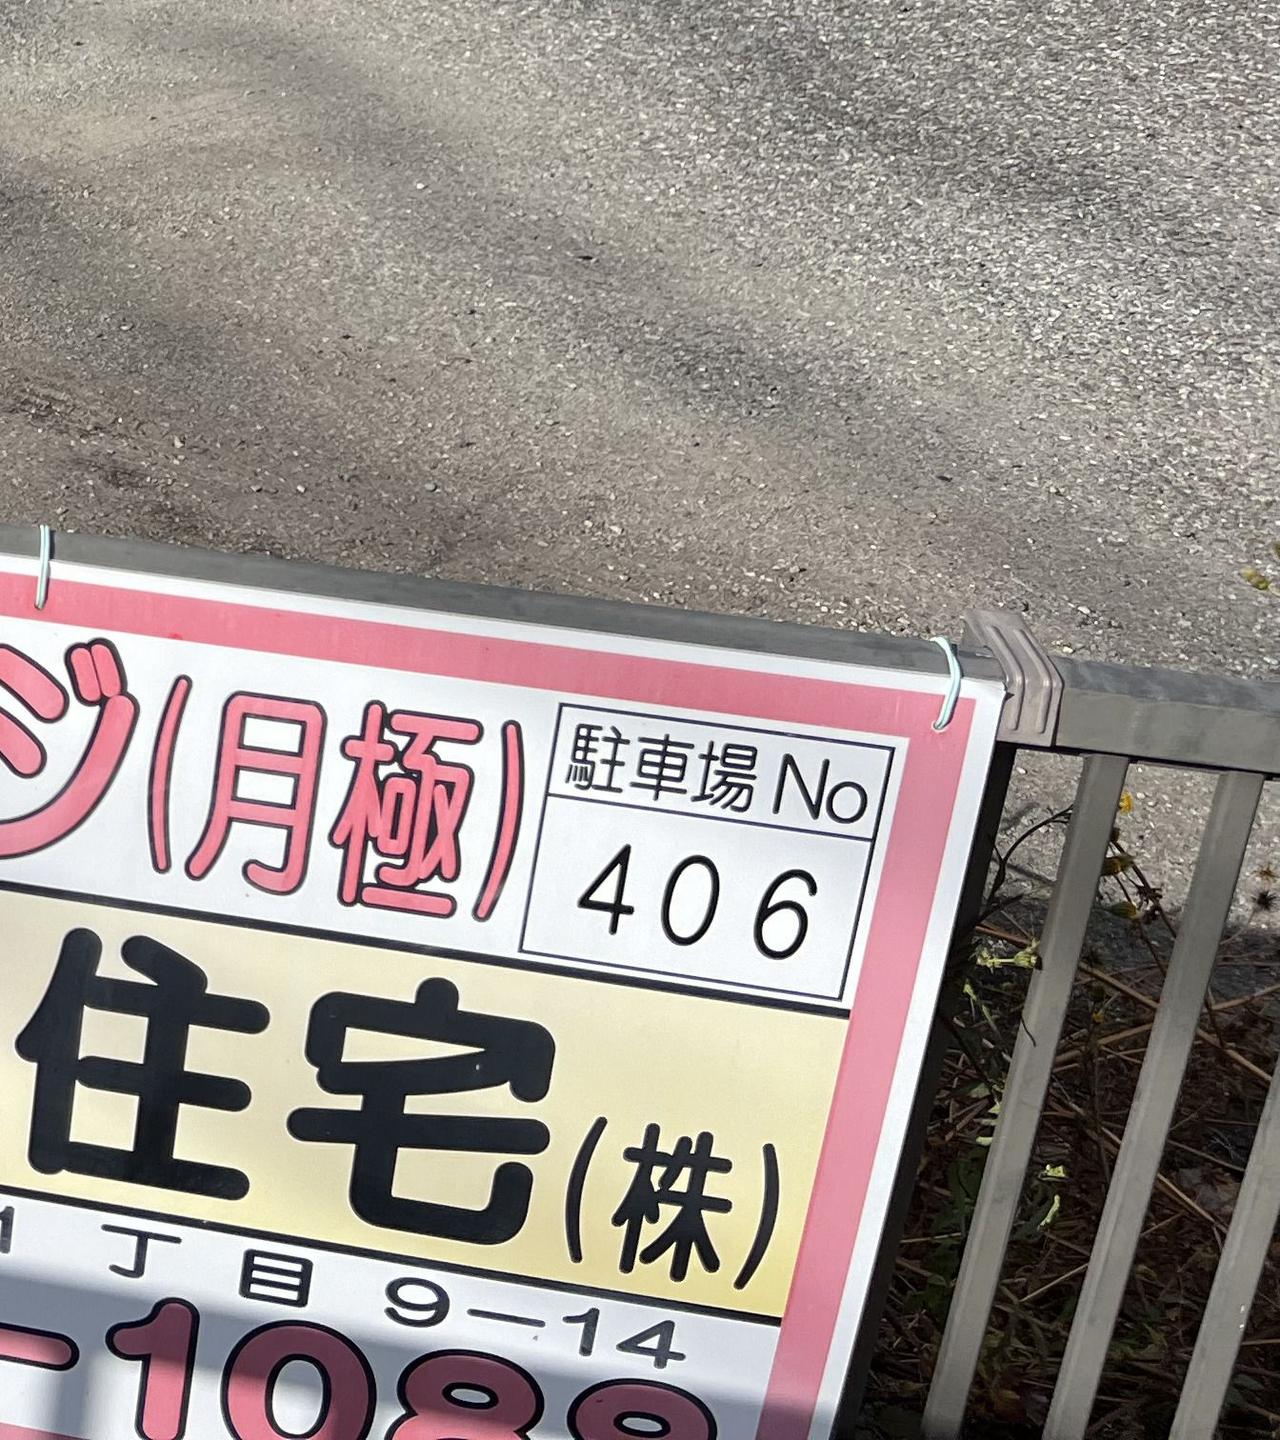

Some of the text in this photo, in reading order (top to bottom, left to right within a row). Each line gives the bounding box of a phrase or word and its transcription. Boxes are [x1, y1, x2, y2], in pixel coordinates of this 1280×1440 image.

[563, 721, 872, 827] 駐車場 No
[578, 844, 820, 962] 406
